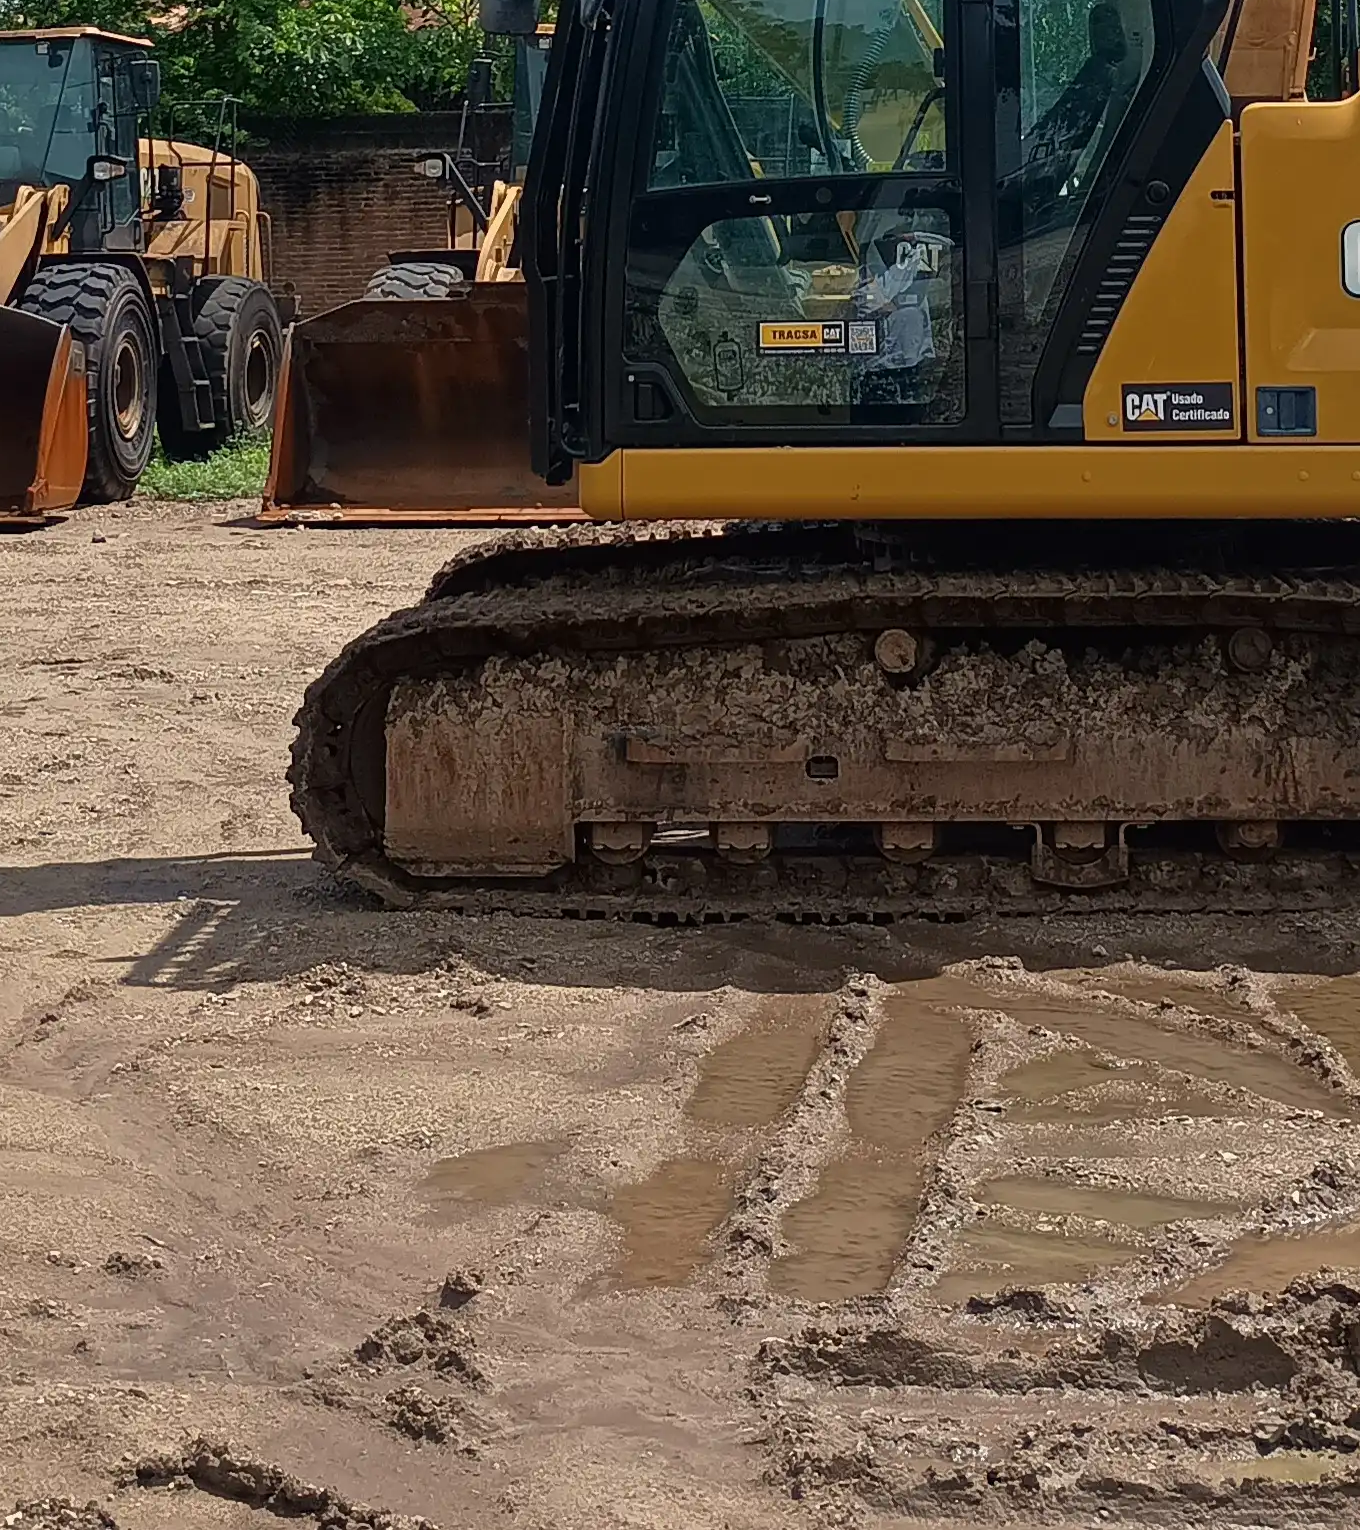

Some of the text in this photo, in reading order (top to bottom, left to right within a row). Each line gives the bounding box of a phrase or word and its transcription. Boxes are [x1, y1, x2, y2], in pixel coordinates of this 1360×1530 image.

[823, 327, 841, 340] CAT
[1125, 392, 1204, 421] CAT Usado
[1172, 408, 1230, 421] Certificado
